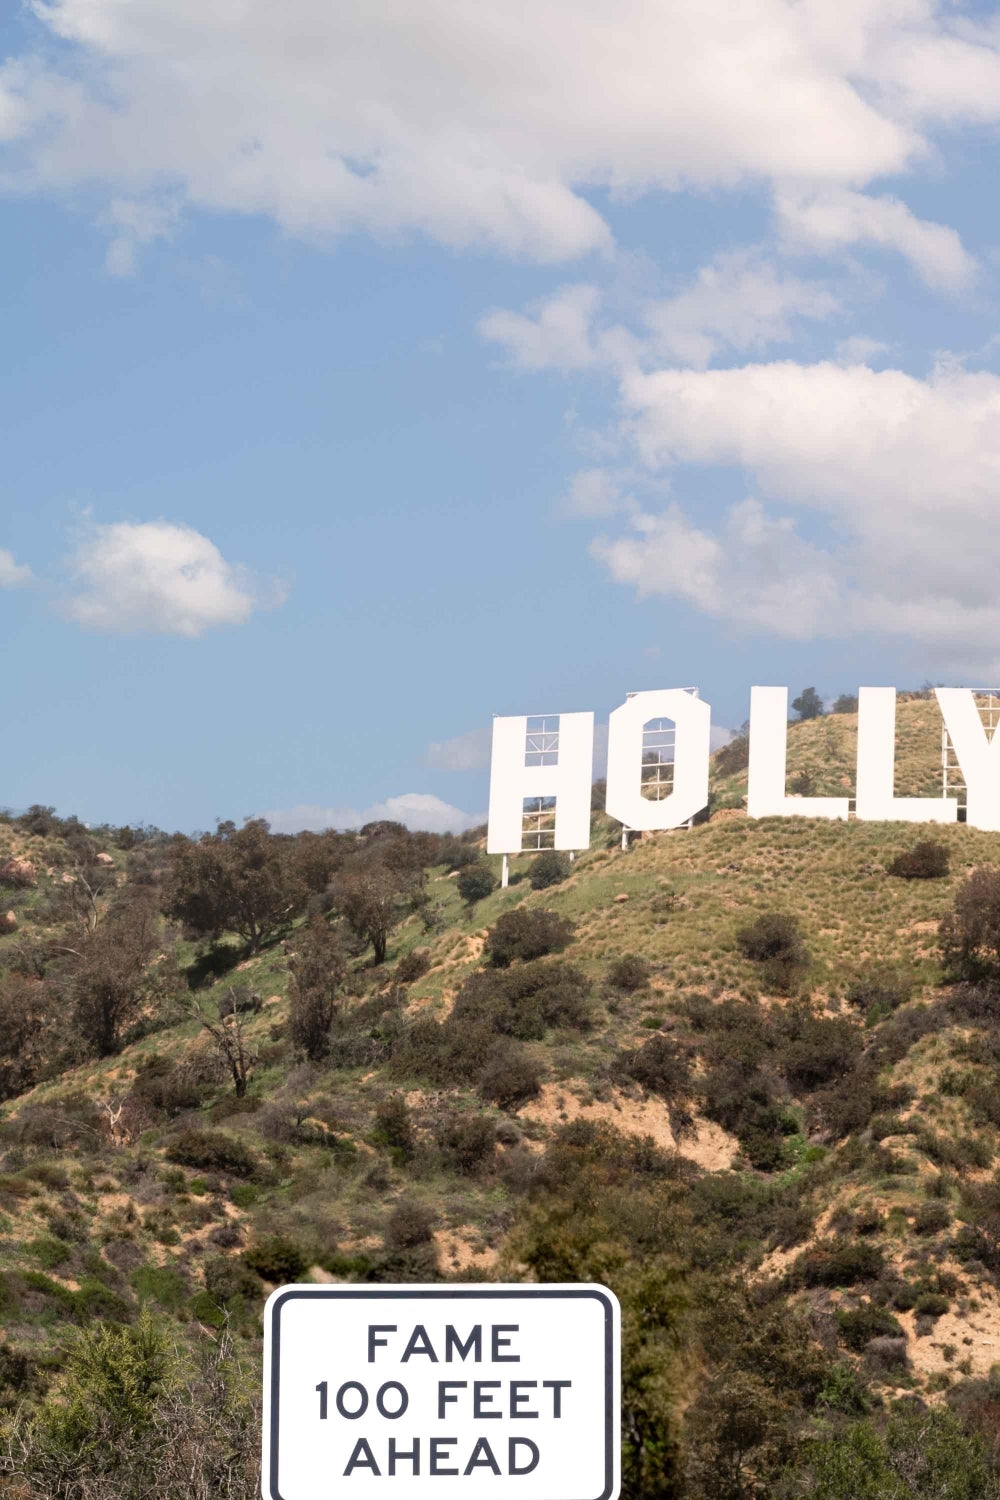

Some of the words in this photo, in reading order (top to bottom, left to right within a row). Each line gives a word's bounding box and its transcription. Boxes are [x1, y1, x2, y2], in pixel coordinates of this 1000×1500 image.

[368, 1324, 521, 1363] FAME
[315, 1380, 410, 1420] 100
[437, 1380, 572, 1419] FEET
[342, 1437, 541, 1476] AHEAD
